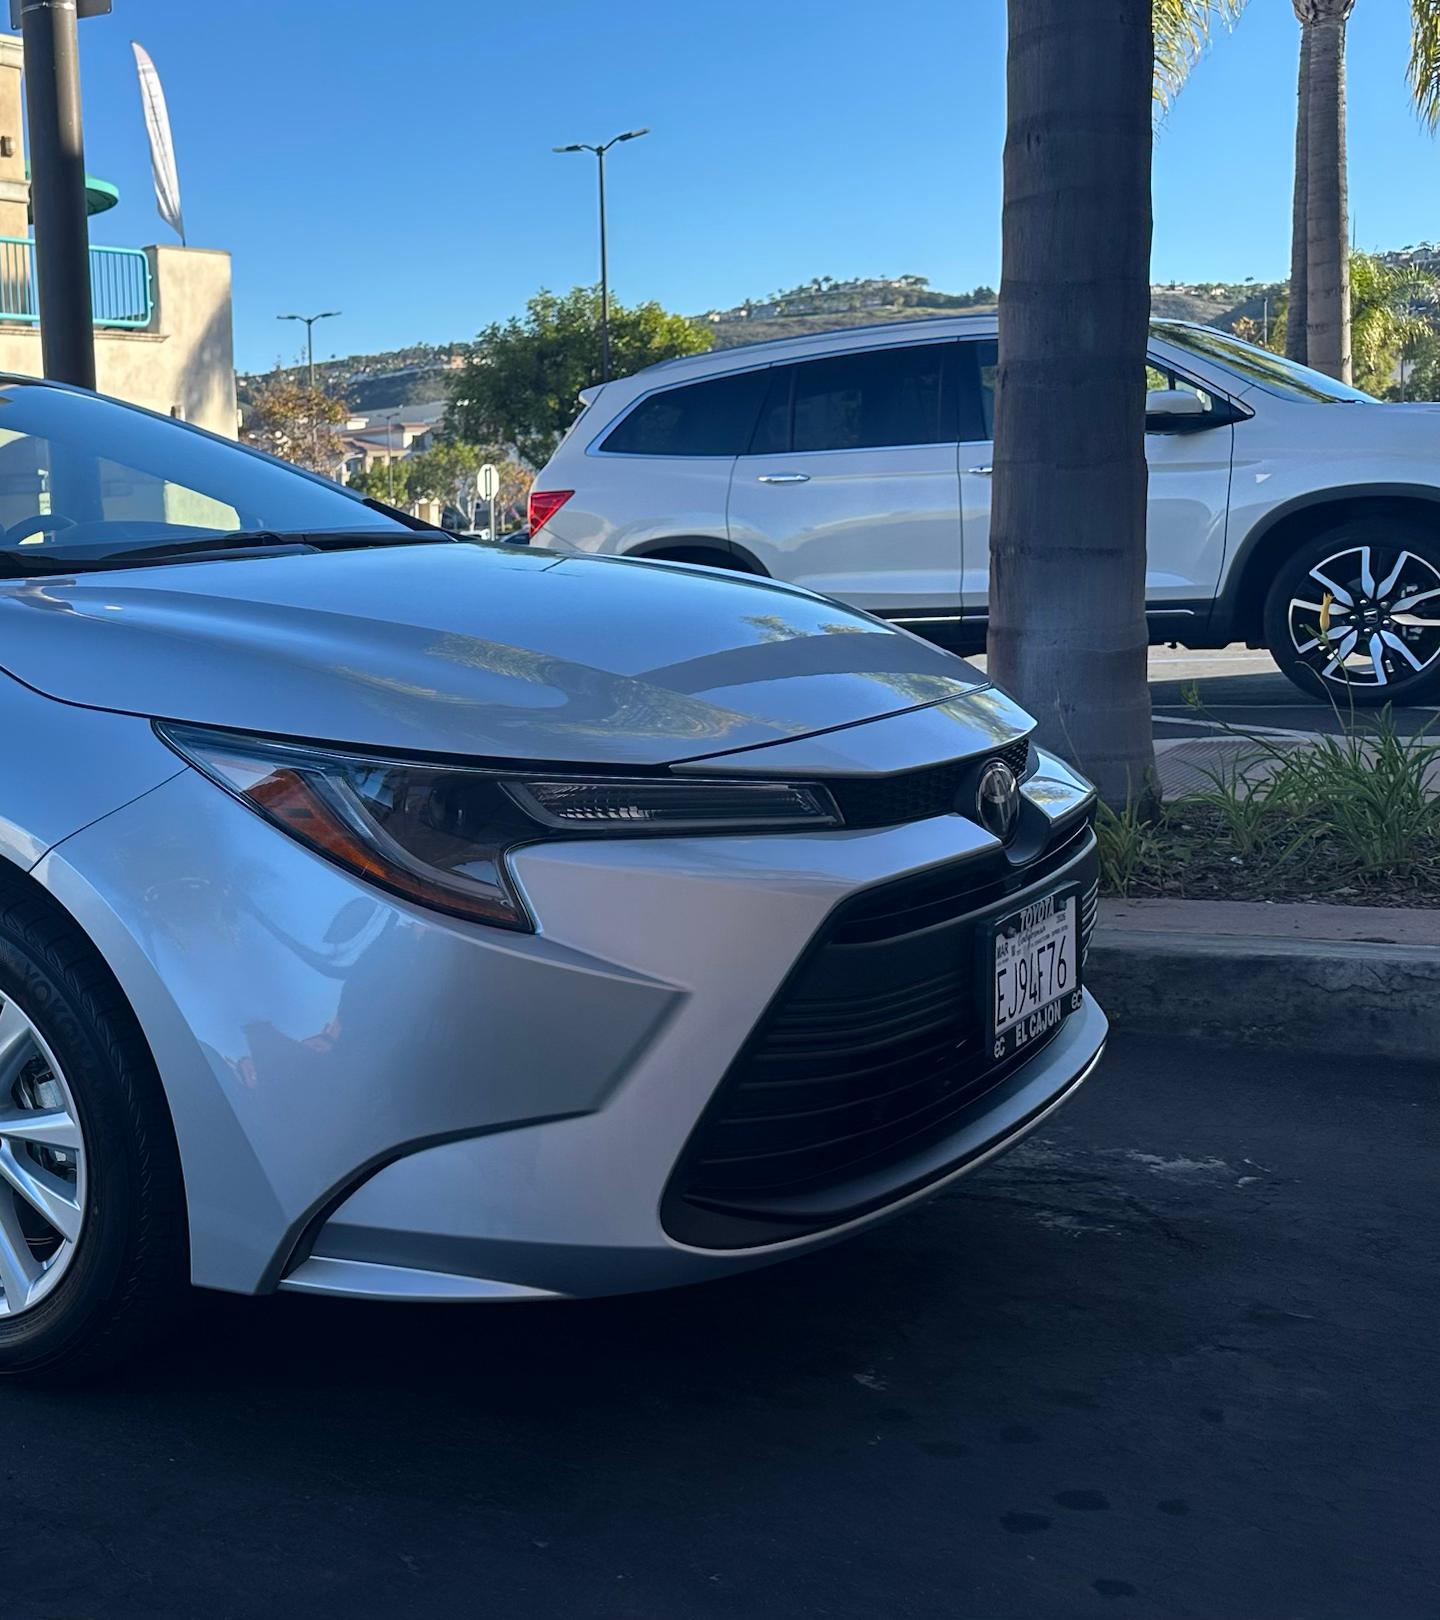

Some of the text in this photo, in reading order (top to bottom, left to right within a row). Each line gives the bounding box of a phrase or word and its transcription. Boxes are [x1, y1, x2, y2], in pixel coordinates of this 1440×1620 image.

[1020, 895, 1055, 933] TOYOTA
[996, 935, 1067, 1027] EJ94F76
[1015, 1000, 1061, 1047] EL CAJON
